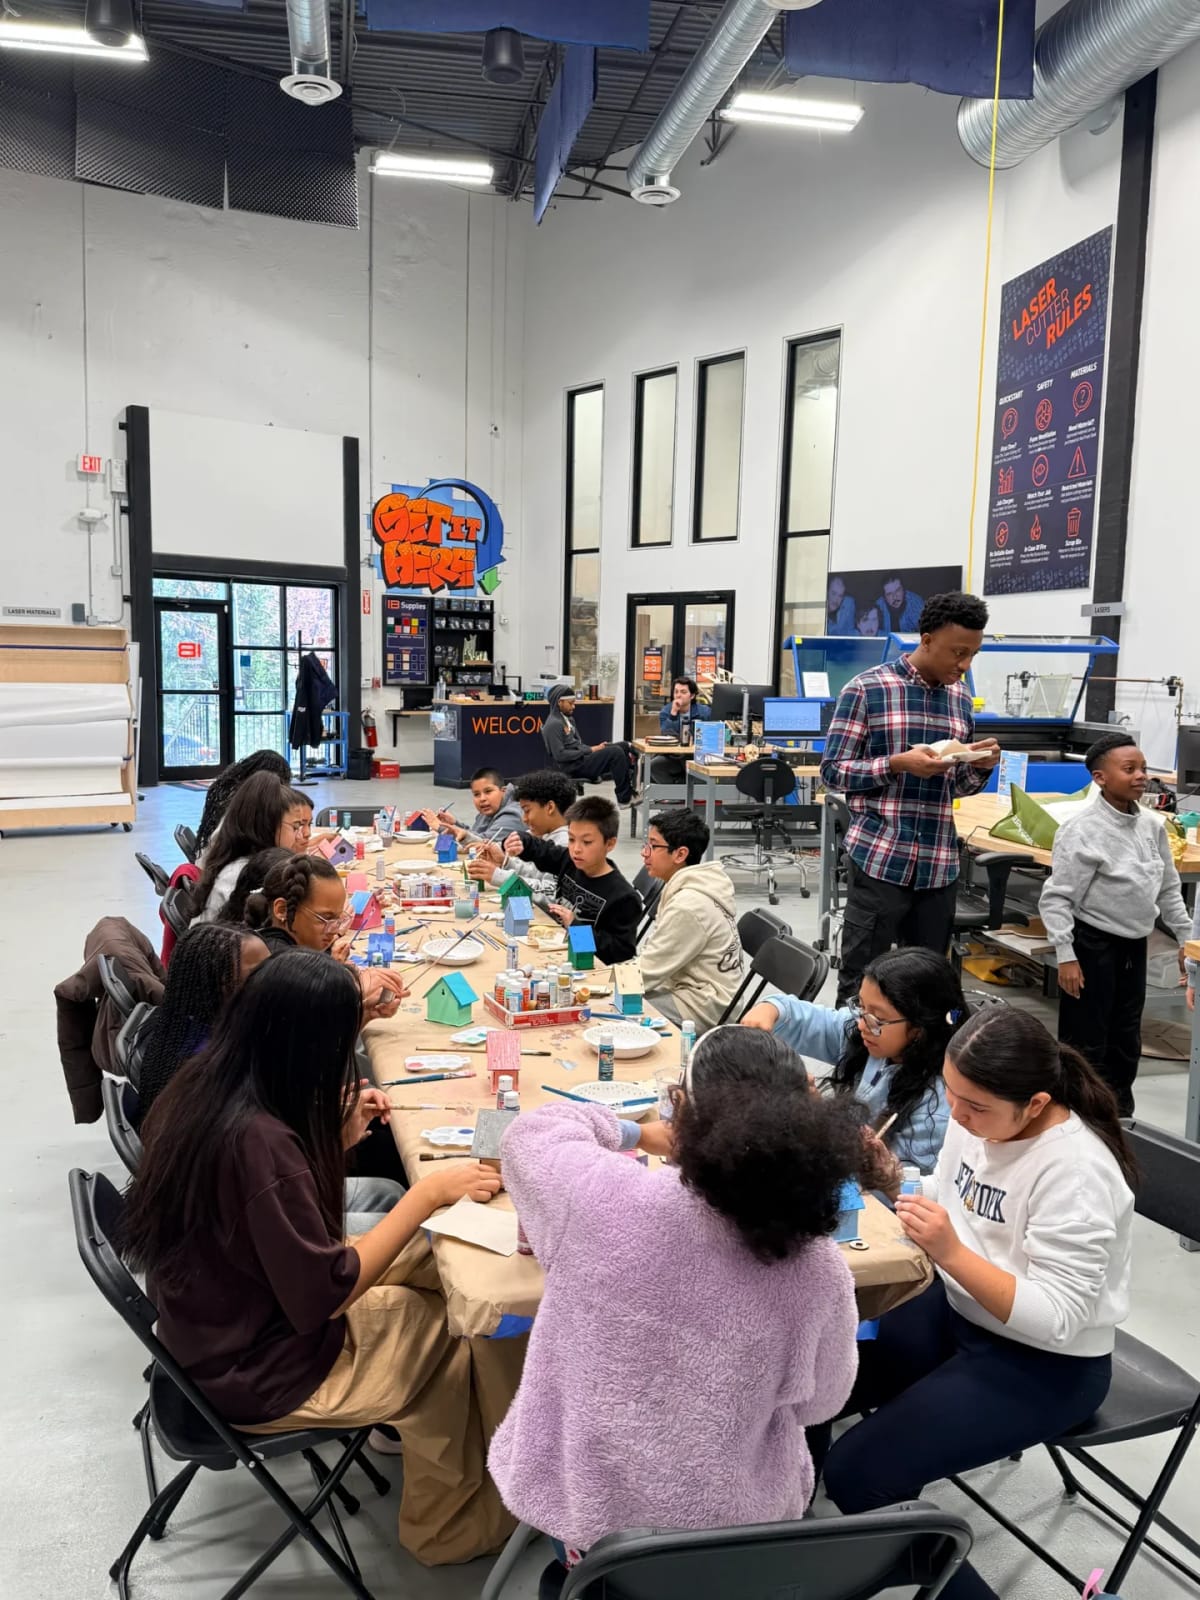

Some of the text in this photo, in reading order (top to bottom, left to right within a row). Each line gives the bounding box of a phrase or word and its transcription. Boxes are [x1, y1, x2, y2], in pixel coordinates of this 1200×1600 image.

[1012, 278, 1057, 341] LASER
[1026, 288, 1070, 345] CUTTER
[1046, 284, 1093, 350] RULES
[1036, 379, 1054, 391] SAFETY
[1070, 361, 1098, 379] MATERIALS
[82, 455, 102, 473] EXIT
[373, 492, 482, 545] GET IT
[381, 540, 477, 594] HERE
[401, 602, 426, 611] Supplies
[471, 715, 544, 735] WELCO
[970, 1177, 1006, 1223] YORK
